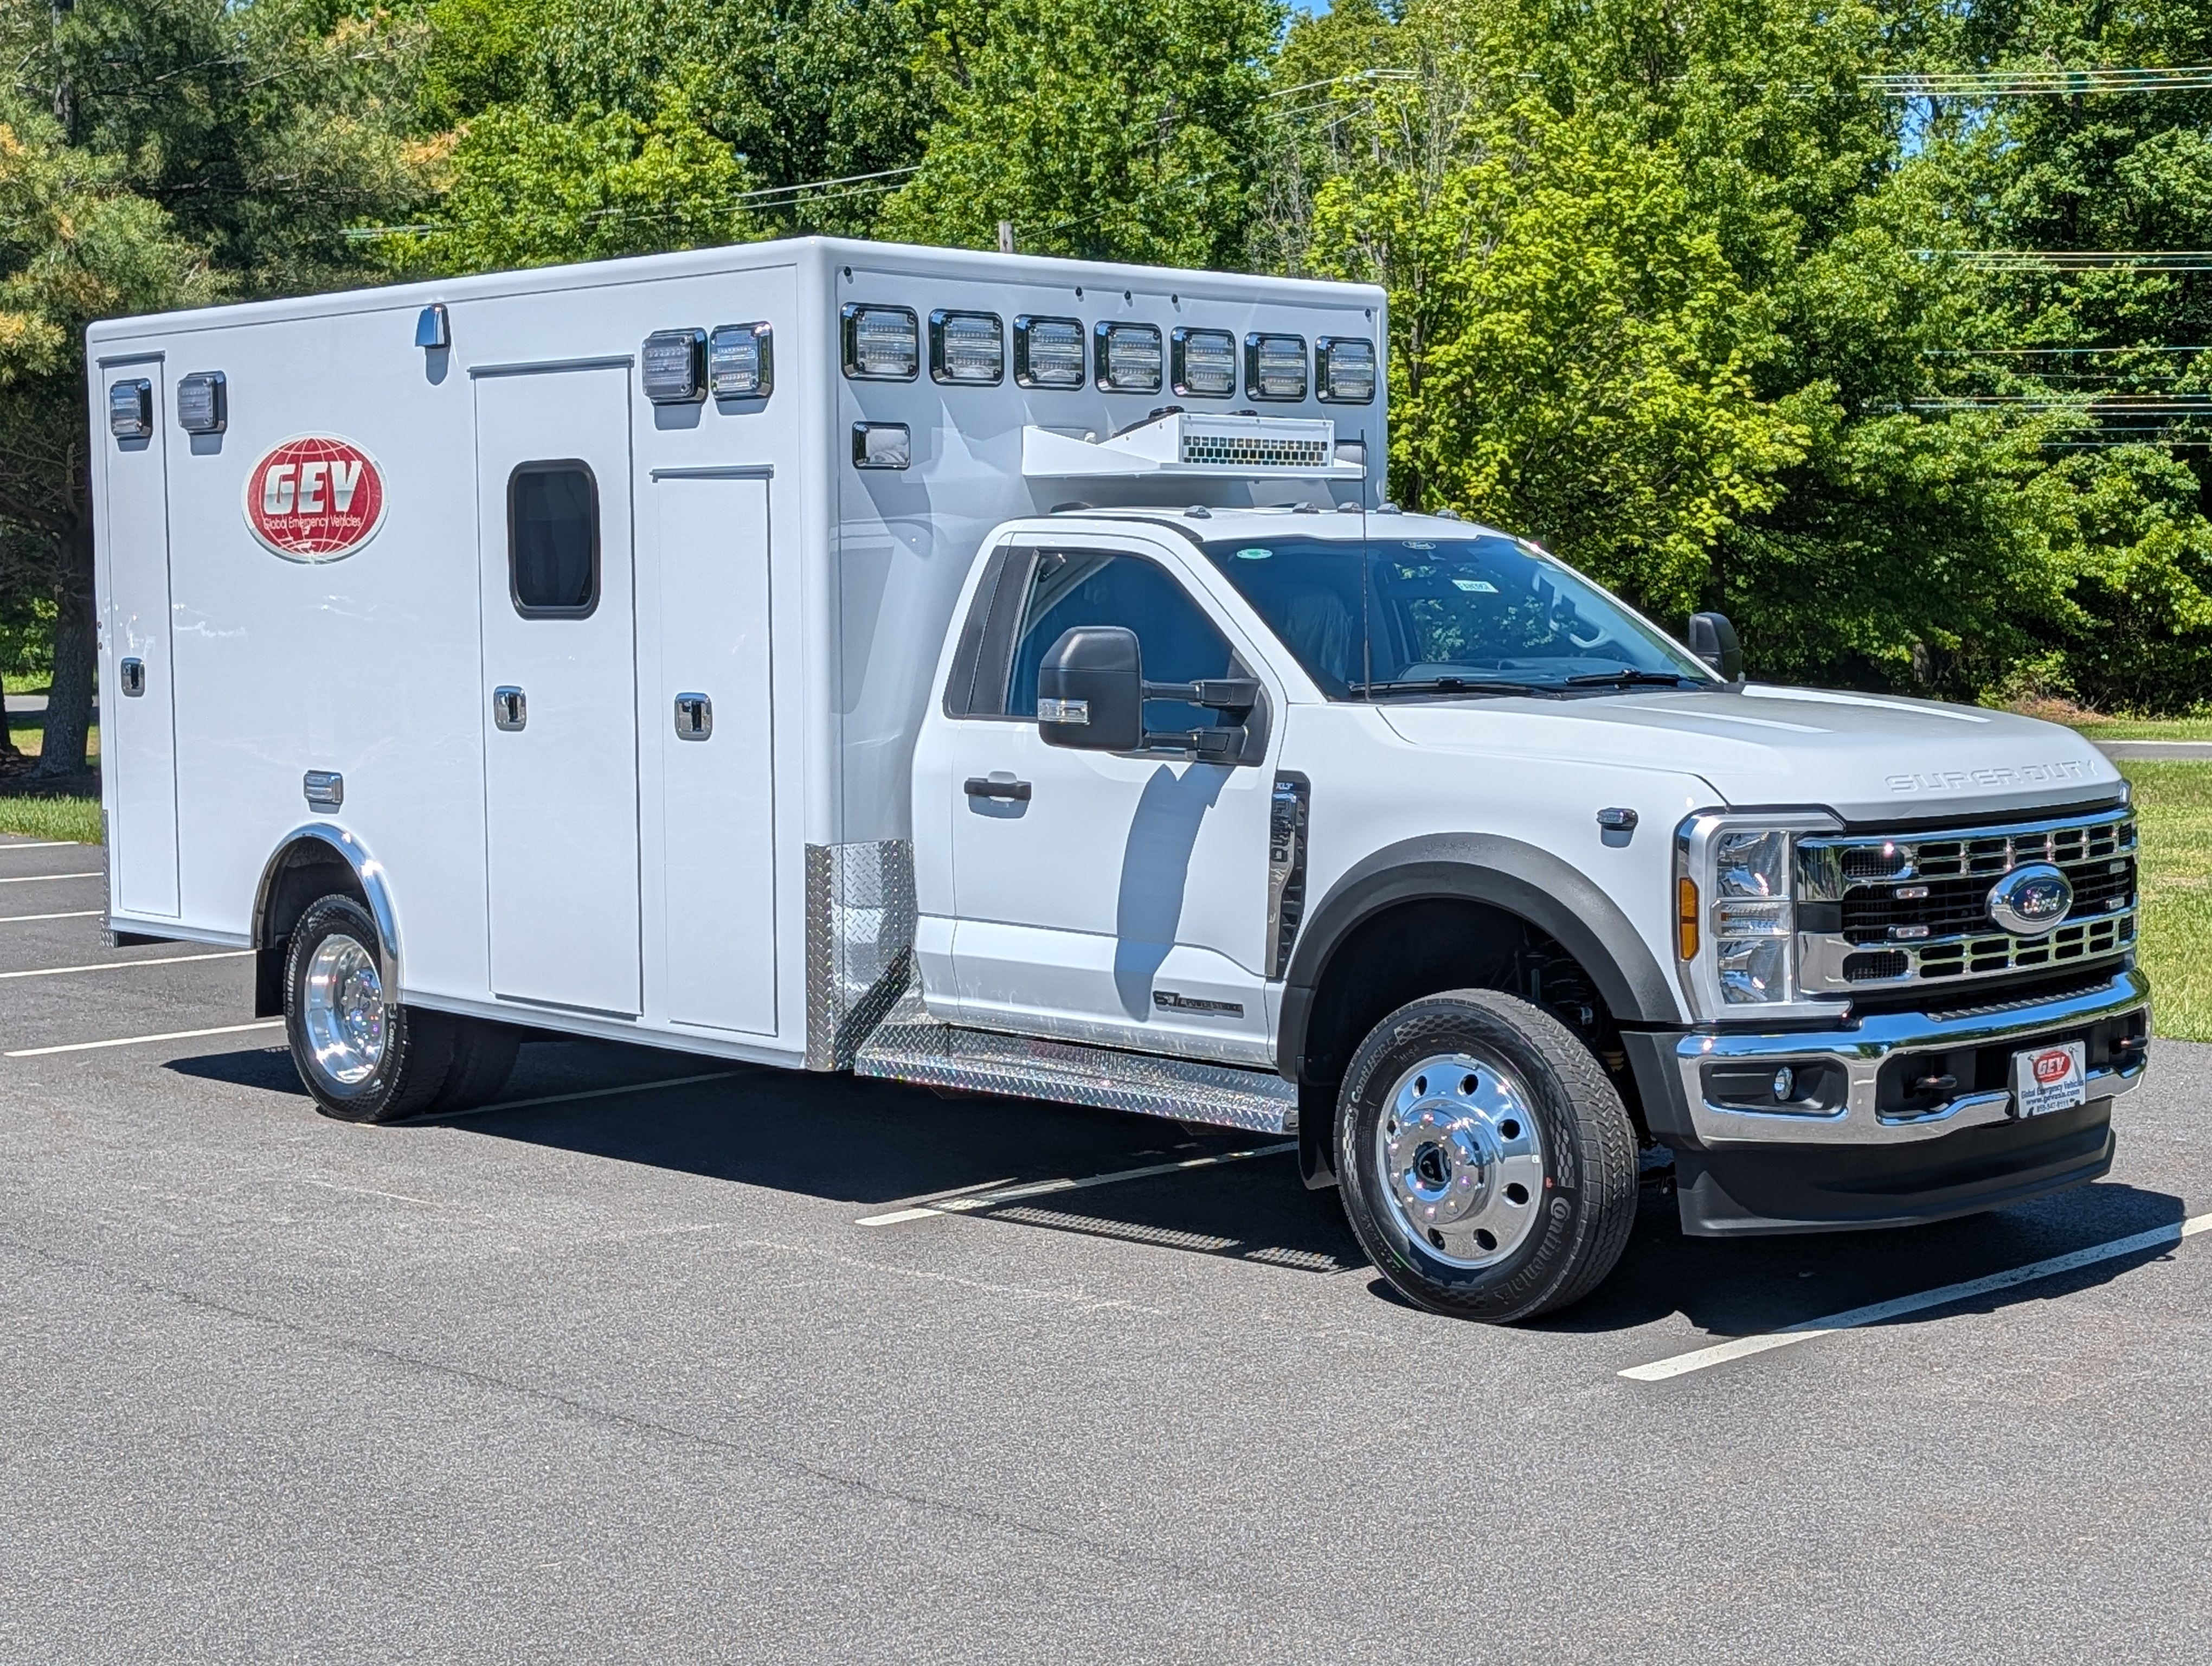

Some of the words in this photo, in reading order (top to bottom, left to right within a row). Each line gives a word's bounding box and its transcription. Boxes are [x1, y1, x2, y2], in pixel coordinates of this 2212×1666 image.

[263, 460, 363, 515] GEV
[263, 517, 287, 530] Global
[288, 516, 329, 530] Emergency
[330, 515, 362, 527] Vehicles
[1885, 767, 2023, 793] SUPER
[2022, 760, 2099, 783] DUTY
[2037, 1056, 2066, 1075] GEV
[1352, 1065, 1371, 1103] Conti
[1506, 1197, 1571, 1299] Continental
